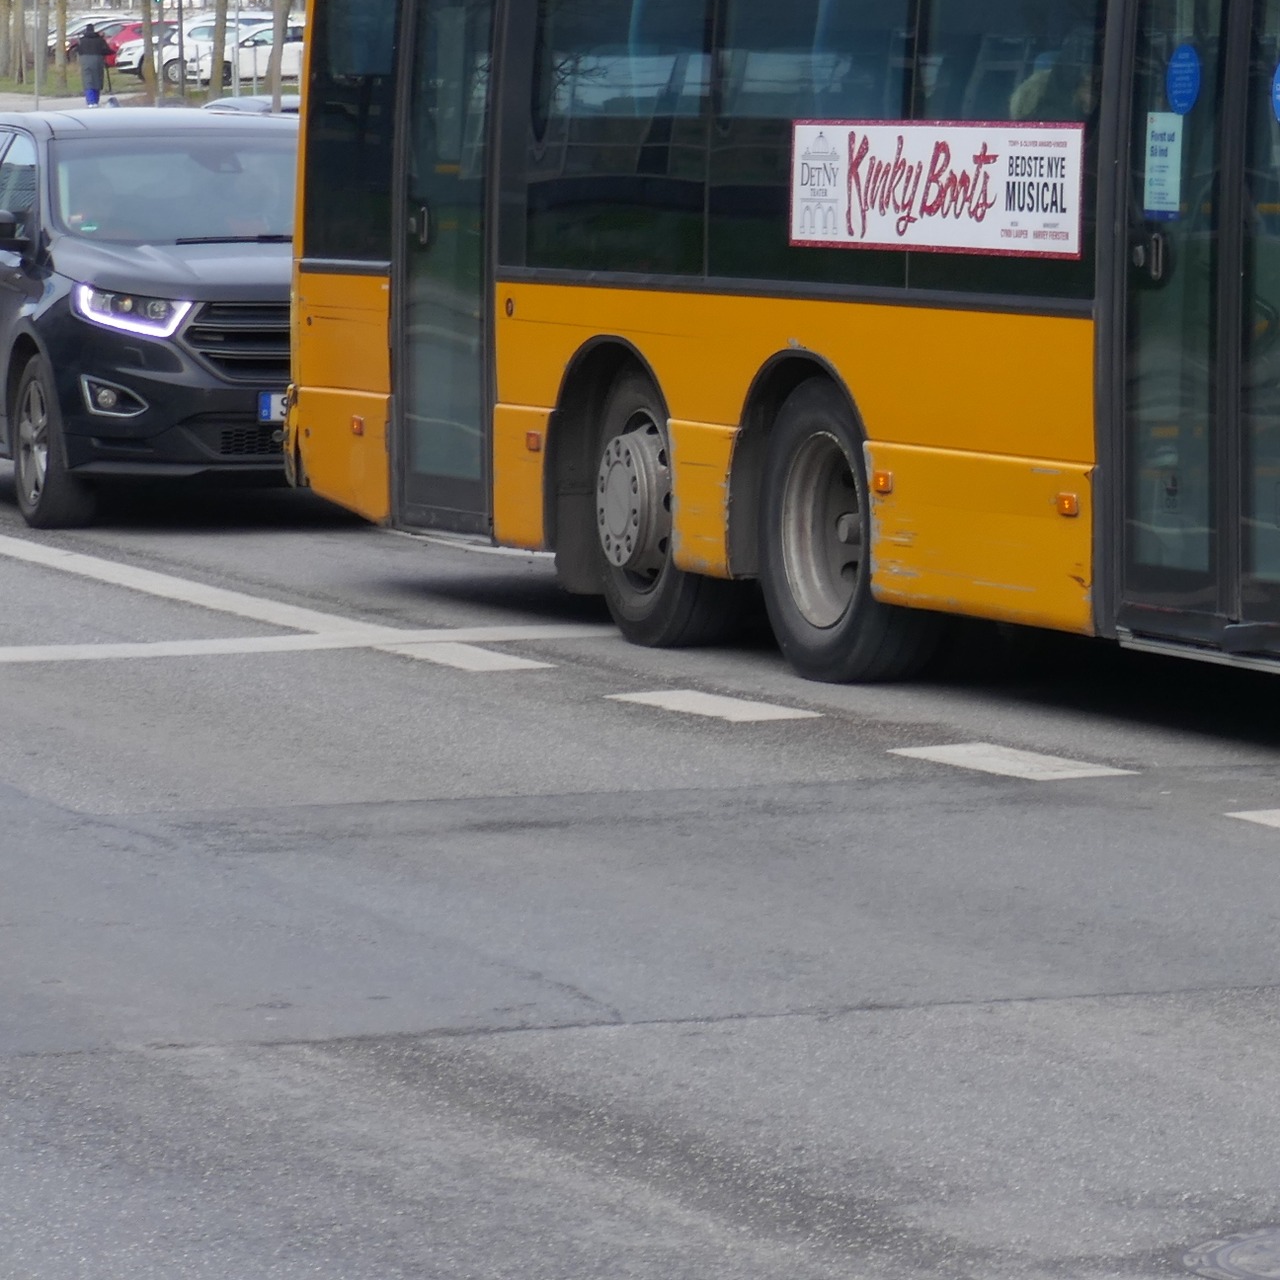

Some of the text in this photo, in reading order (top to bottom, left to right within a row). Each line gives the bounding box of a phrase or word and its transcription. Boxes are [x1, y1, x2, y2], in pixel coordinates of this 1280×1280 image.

[1008, 156, 1066, 178] BEDSTE NYE
[846, 131, 999, 238] Kinky Boots
[1005, 181, 1066, 214] MUSICAL
